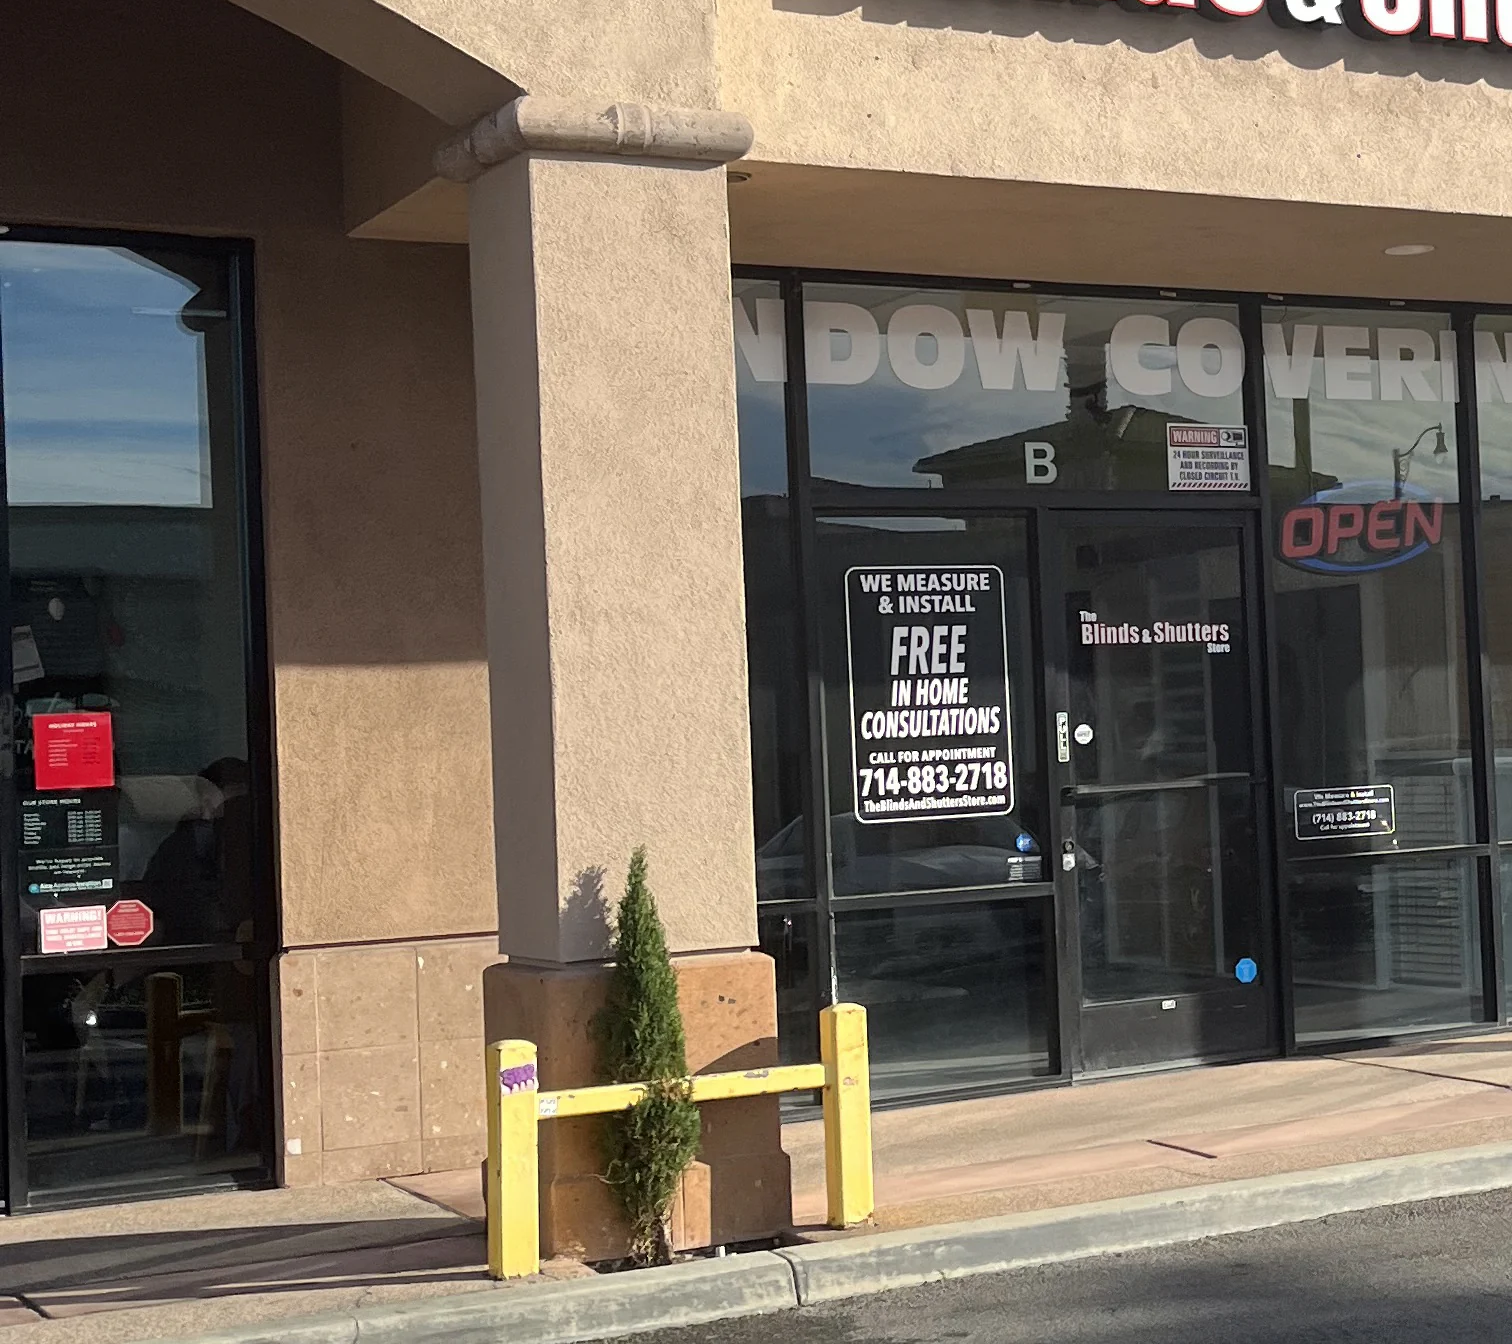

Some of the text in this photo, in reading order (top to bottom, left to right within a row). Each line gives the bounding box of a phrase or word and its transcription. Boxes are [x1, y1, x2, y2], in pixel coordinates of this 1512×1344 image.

[1172, 430, 1218, 444] WARNING
[1025, 442, 1058, 484] B
[1173, 451, 1245, 460] 24 HOUR SURVEILLANCE
[1180, 461, 1239, 470] AND RECORDING BY
[1180, 472, 1202, 481] CLOSED
[1204, 472, 1229, 481] CIRCUIT
[1282, 498, 1443, 558] OPEN
[860, 573, 990, 592] WE MEASURE
[878, 595, 976, 614] & INSTALL
[1079, 610, 1097, 622] The
[1081, 622, 1230, 645] Blinds & Shutters
[890, 625, 967, 676] FREE
[1207, 643, 1231, 653] Store
[891, 678, 969, 706] IN HOME
[861, 706, 1001, 739] CONSULTATIONS
[869, 746, 997, 764] CALL FOR APPOINTMENT
[859, 761, 1008, 797] 714-883-2718
[864, 794, 1006, 813] TheBlindsAndShuttersStore.com
[1312, 809, 1377, 825] (714) 883-2718
